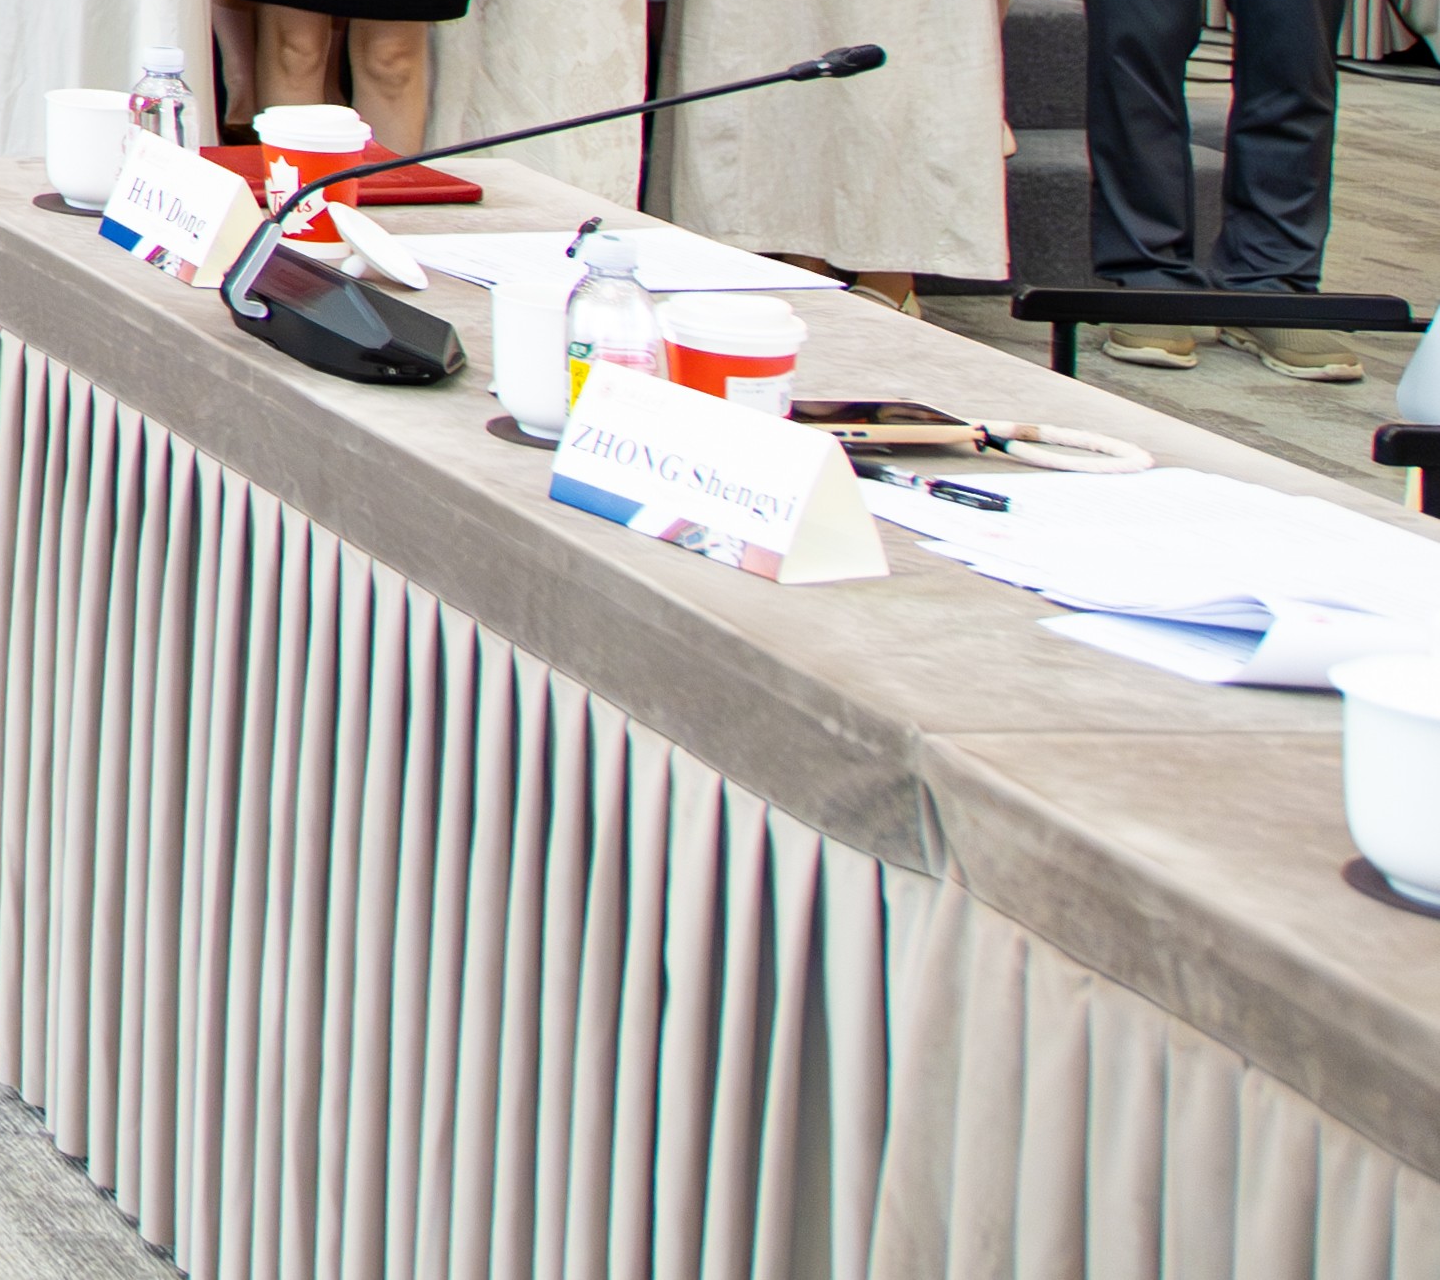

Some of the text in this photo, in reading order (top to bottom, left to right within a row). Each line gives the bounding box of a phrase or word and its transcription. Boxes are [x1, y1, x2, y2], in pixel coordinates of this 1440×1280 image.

[127, 177, 165, 214] HAN
[269, 189, 313, 216] Tis
[571, 424, 684, 482] ZHONG
